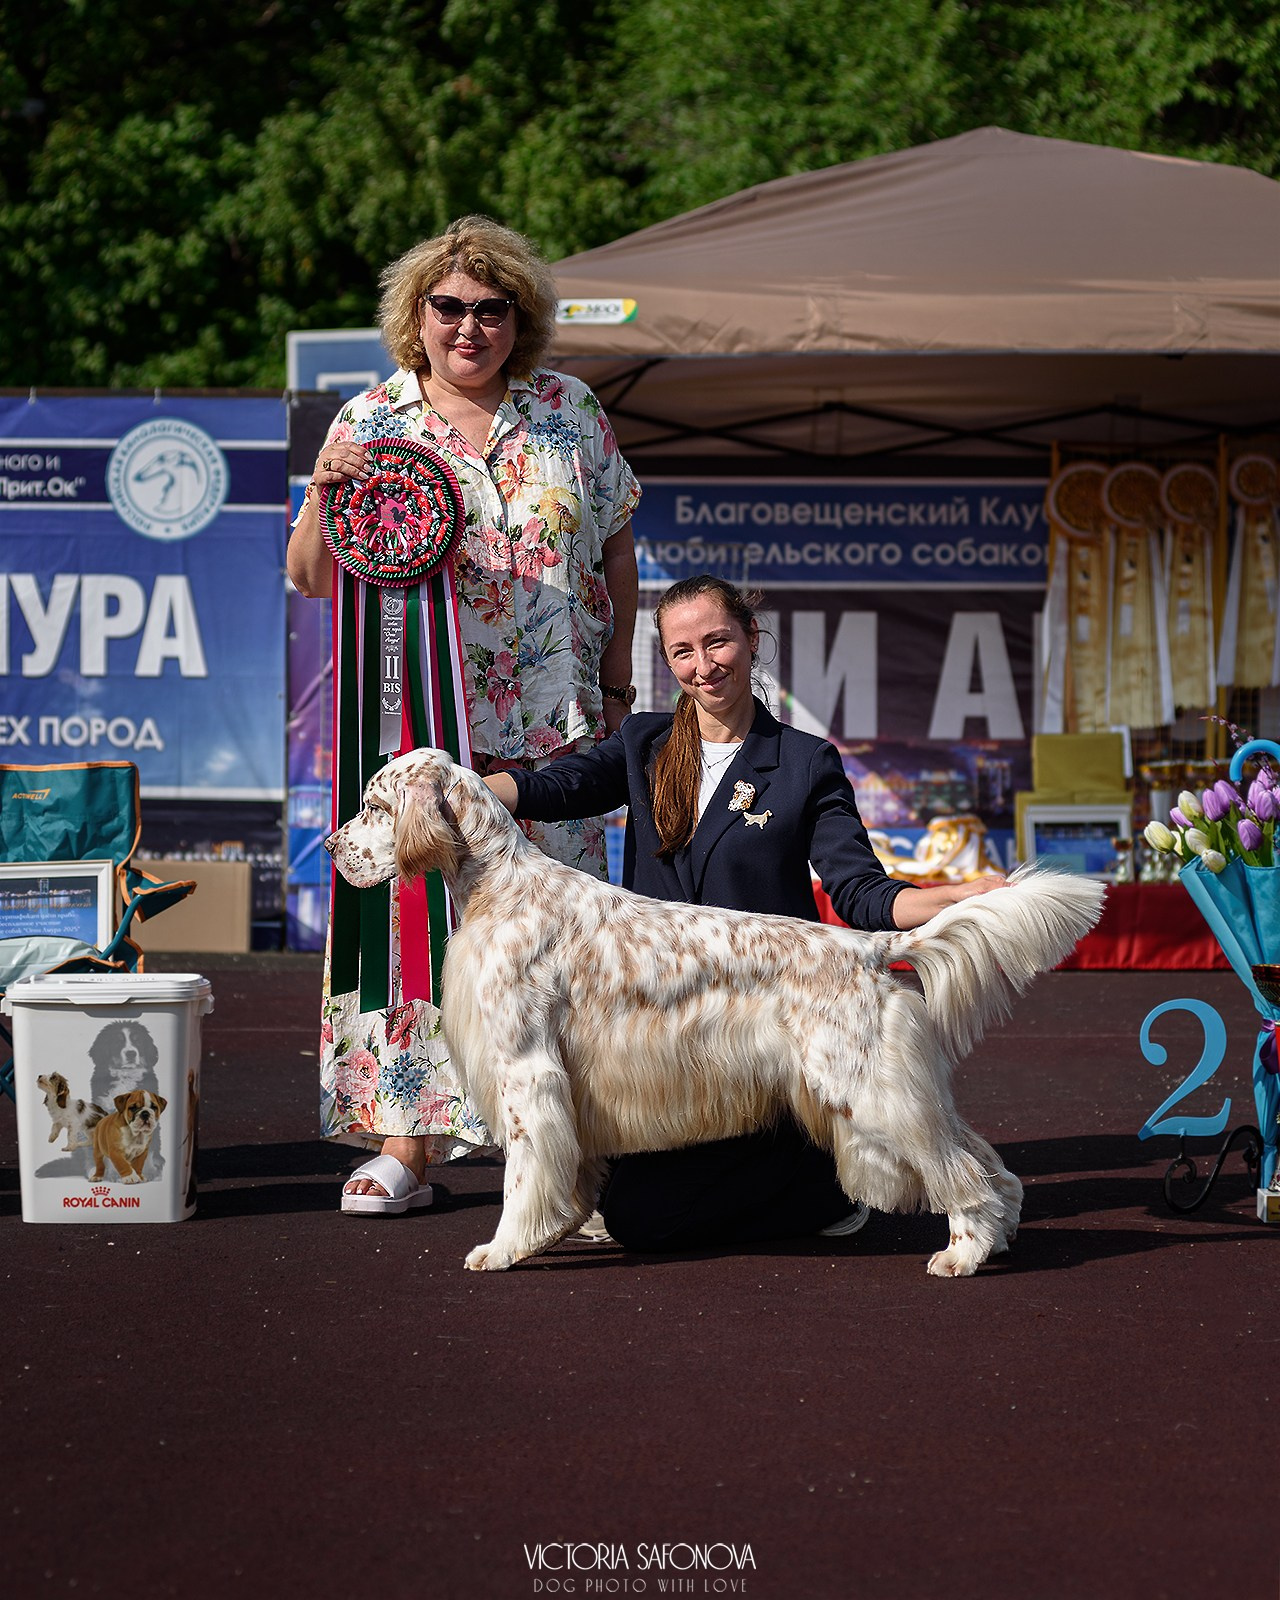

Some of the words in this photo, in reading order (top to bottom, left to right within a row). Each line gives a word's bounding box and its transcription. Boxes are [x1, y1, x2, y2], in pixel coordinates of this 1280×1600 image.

[45, 454, 60, 471] и
[675, 495, 970, 530] Благовещенский
[911, 537, 1049, 566] собако
[0, 572, 208, 678] УРА
[382, 682, 401, 694] BIS
[38, 716, 164, 752] ПОРОД
[1138, 998, 1232, 1140] 2
[63, 1197, 100, 1208] ROYAL
[101, 1197, 140, 1208] CANIN
